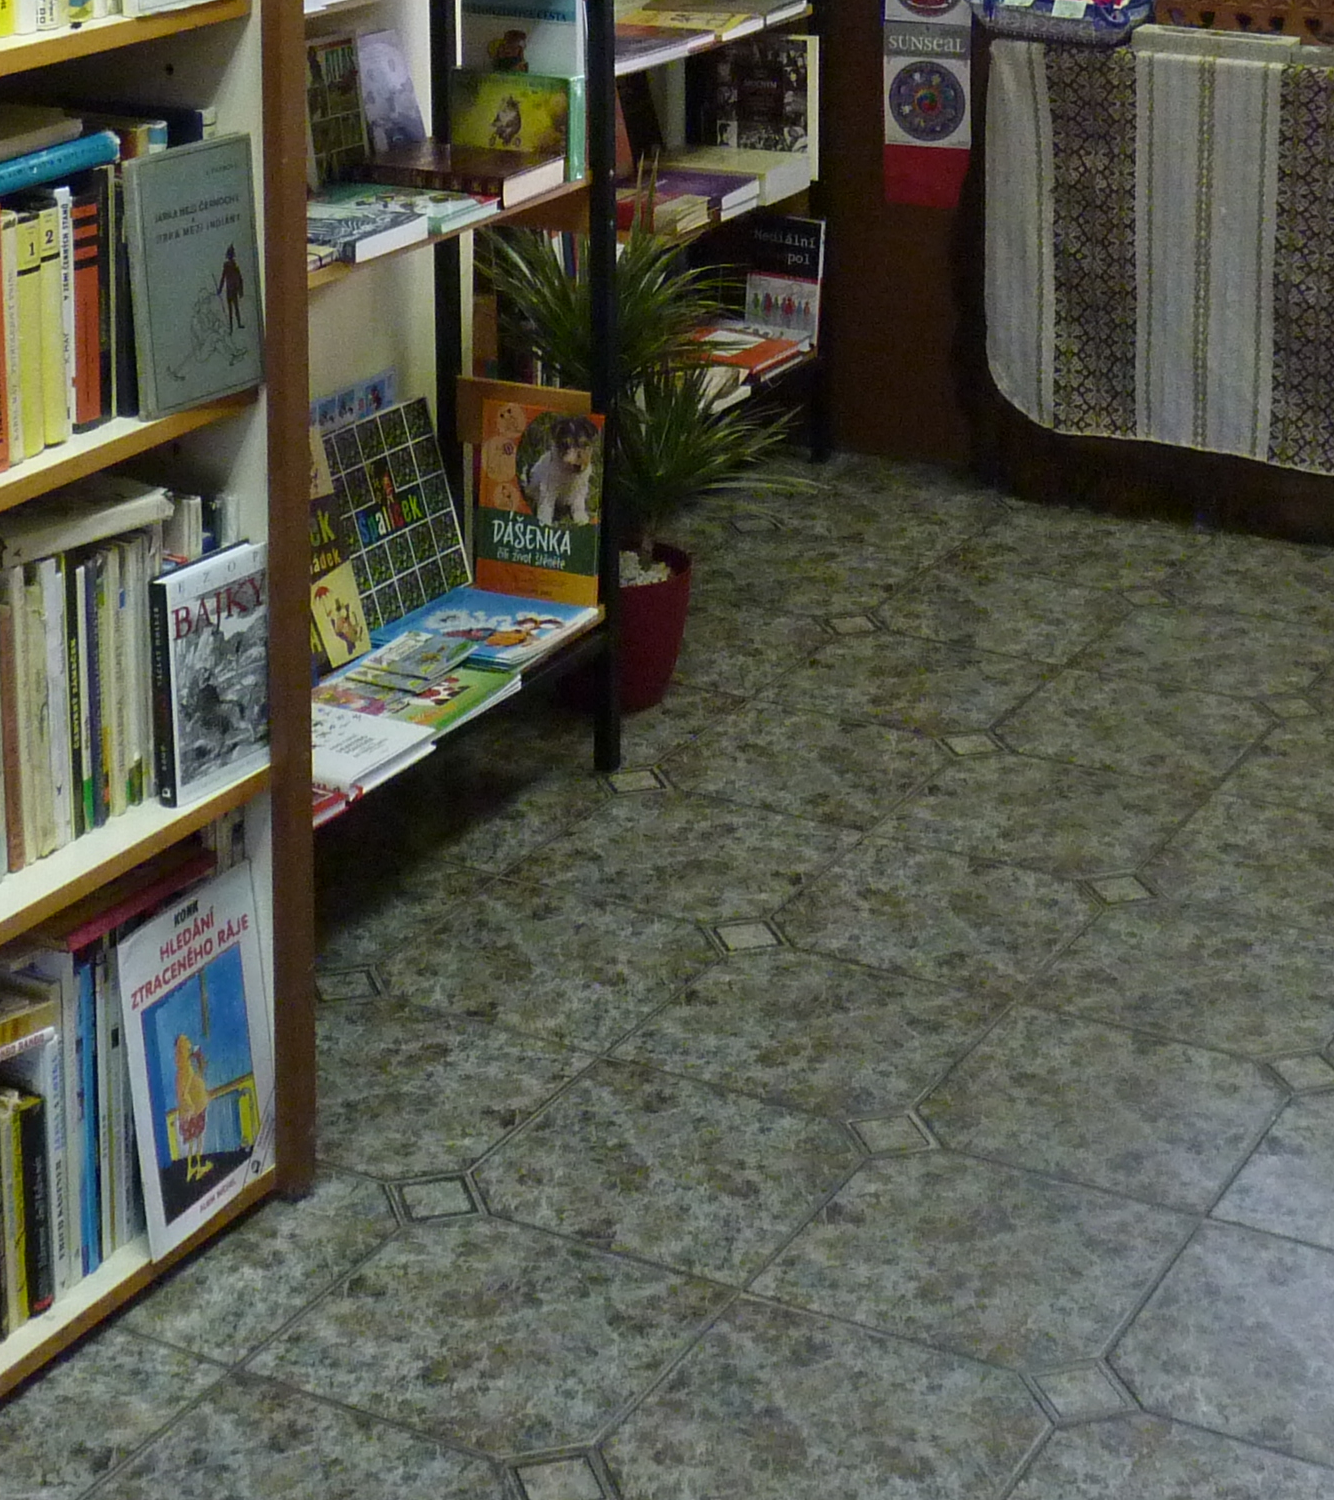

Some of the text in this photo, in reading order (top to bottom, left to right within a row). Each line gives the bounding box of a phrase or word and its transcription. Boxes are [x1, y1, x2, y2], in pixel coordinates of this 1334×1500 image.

[28, 242, 37, 257] 1
[44, 229, 54, 245] 2
[492, 510, 573, 557] DÁŠEŇKA
[171, 575, 264, 641] BAJKY
[159, 904, 215, 963] HLEDÁNÍ
[130, 913, 250, 1011] ZTRACENÉHO RÁJE
